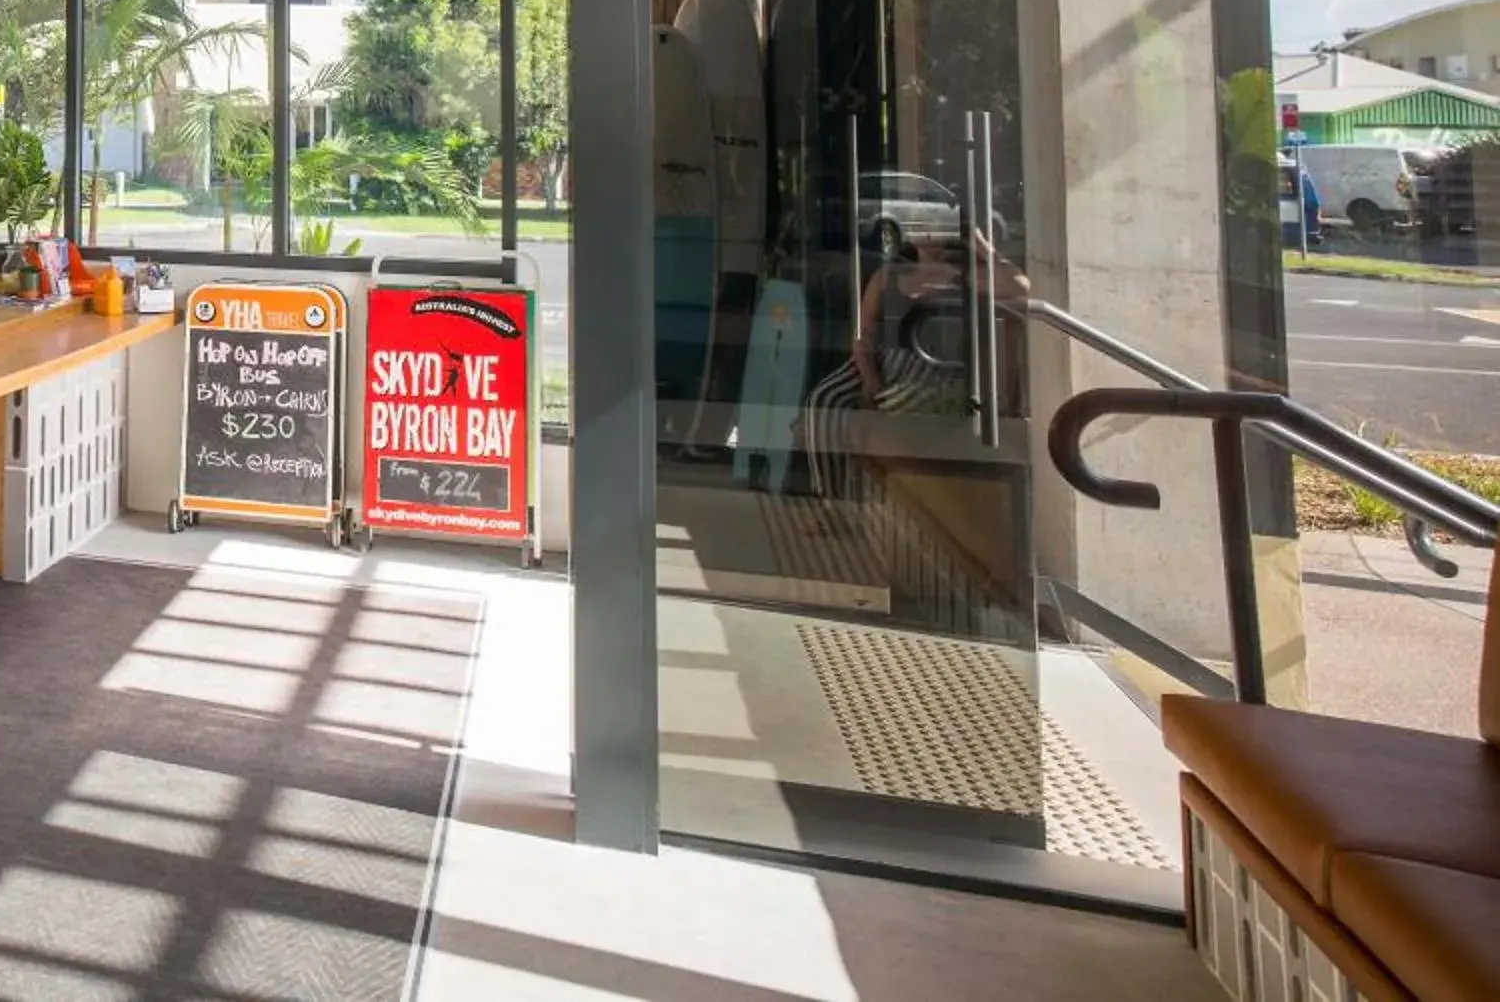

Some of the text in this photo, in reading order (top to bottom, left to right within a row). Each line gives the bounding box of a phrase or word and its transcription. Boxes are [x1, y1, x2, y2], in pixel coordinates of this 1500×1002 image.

[220, 299, 264, 331] YHA
[371, 350, 500, 402] SKYDVE
[197, 383, 257, 407] BYRON
[221, 412, 296, 439] $230
[371, 402, 516, 459] BYRON BAY
